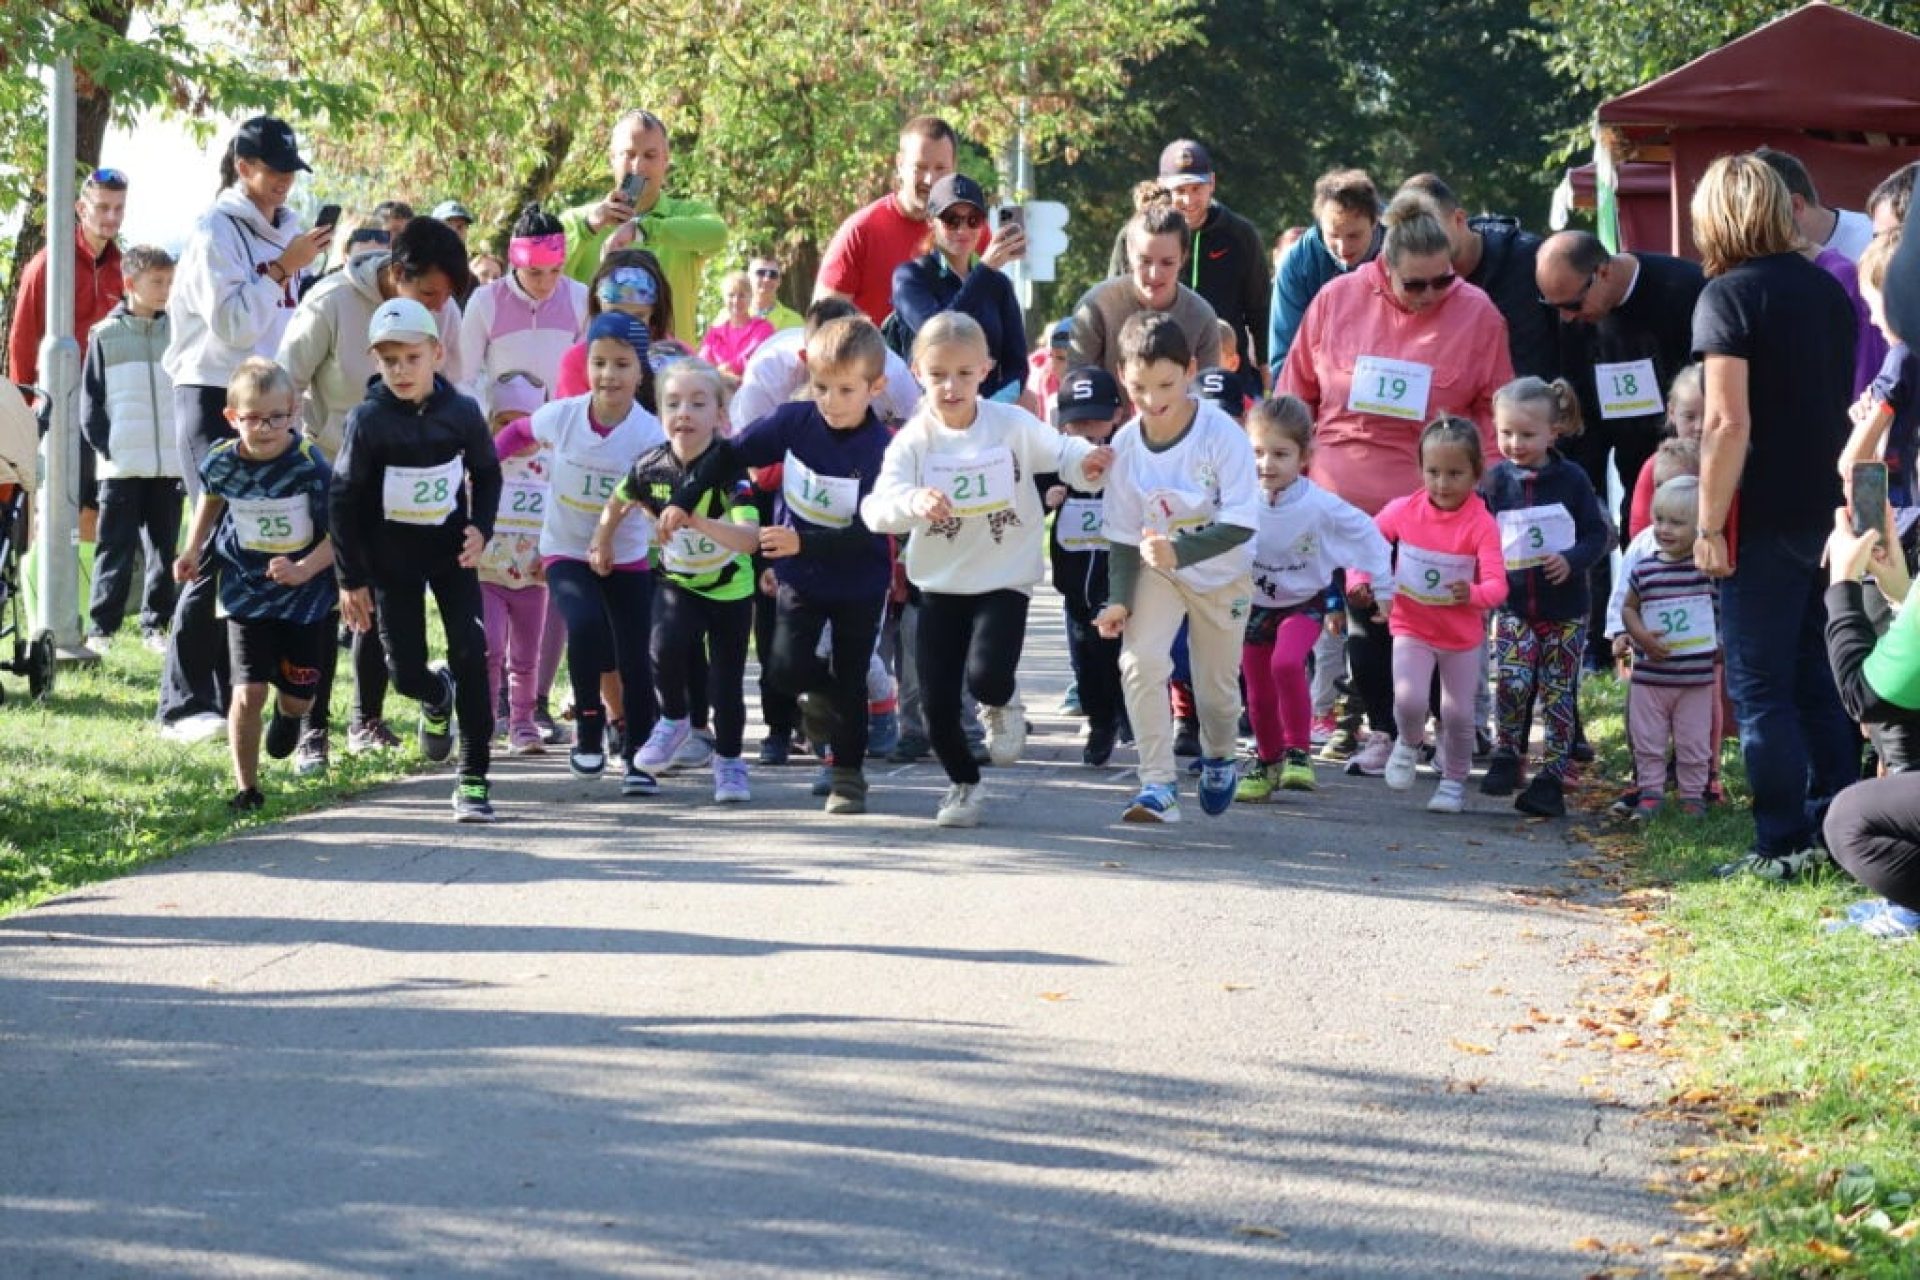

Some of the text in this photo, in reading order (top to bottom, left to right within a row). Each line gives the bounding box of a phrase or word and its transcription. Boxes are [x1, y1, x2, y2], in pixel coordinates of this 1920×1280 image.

[1072, 379, 1093, 399] S
[1202, 373, 1224, 393] S
[1377, 376, 1407, 400] 19
[1613, 373, 1638, 397] 18
[413, 478, 450, 504] 28
[582, 473, 615, 498] 15
[801, 479, 831, 509] 14
[953, 473, 988, 500] 21
[513, 491, 543, 513] 22
[257, 516, 294, 537] 25
[1082, 511, 1103, 532] 2
[682, 537, 715, 556] 16
[1528, 525, 1544, 548] 3
[1424, 569, 1441, 589] 9
[1658, 608, 1690, 634] 32
